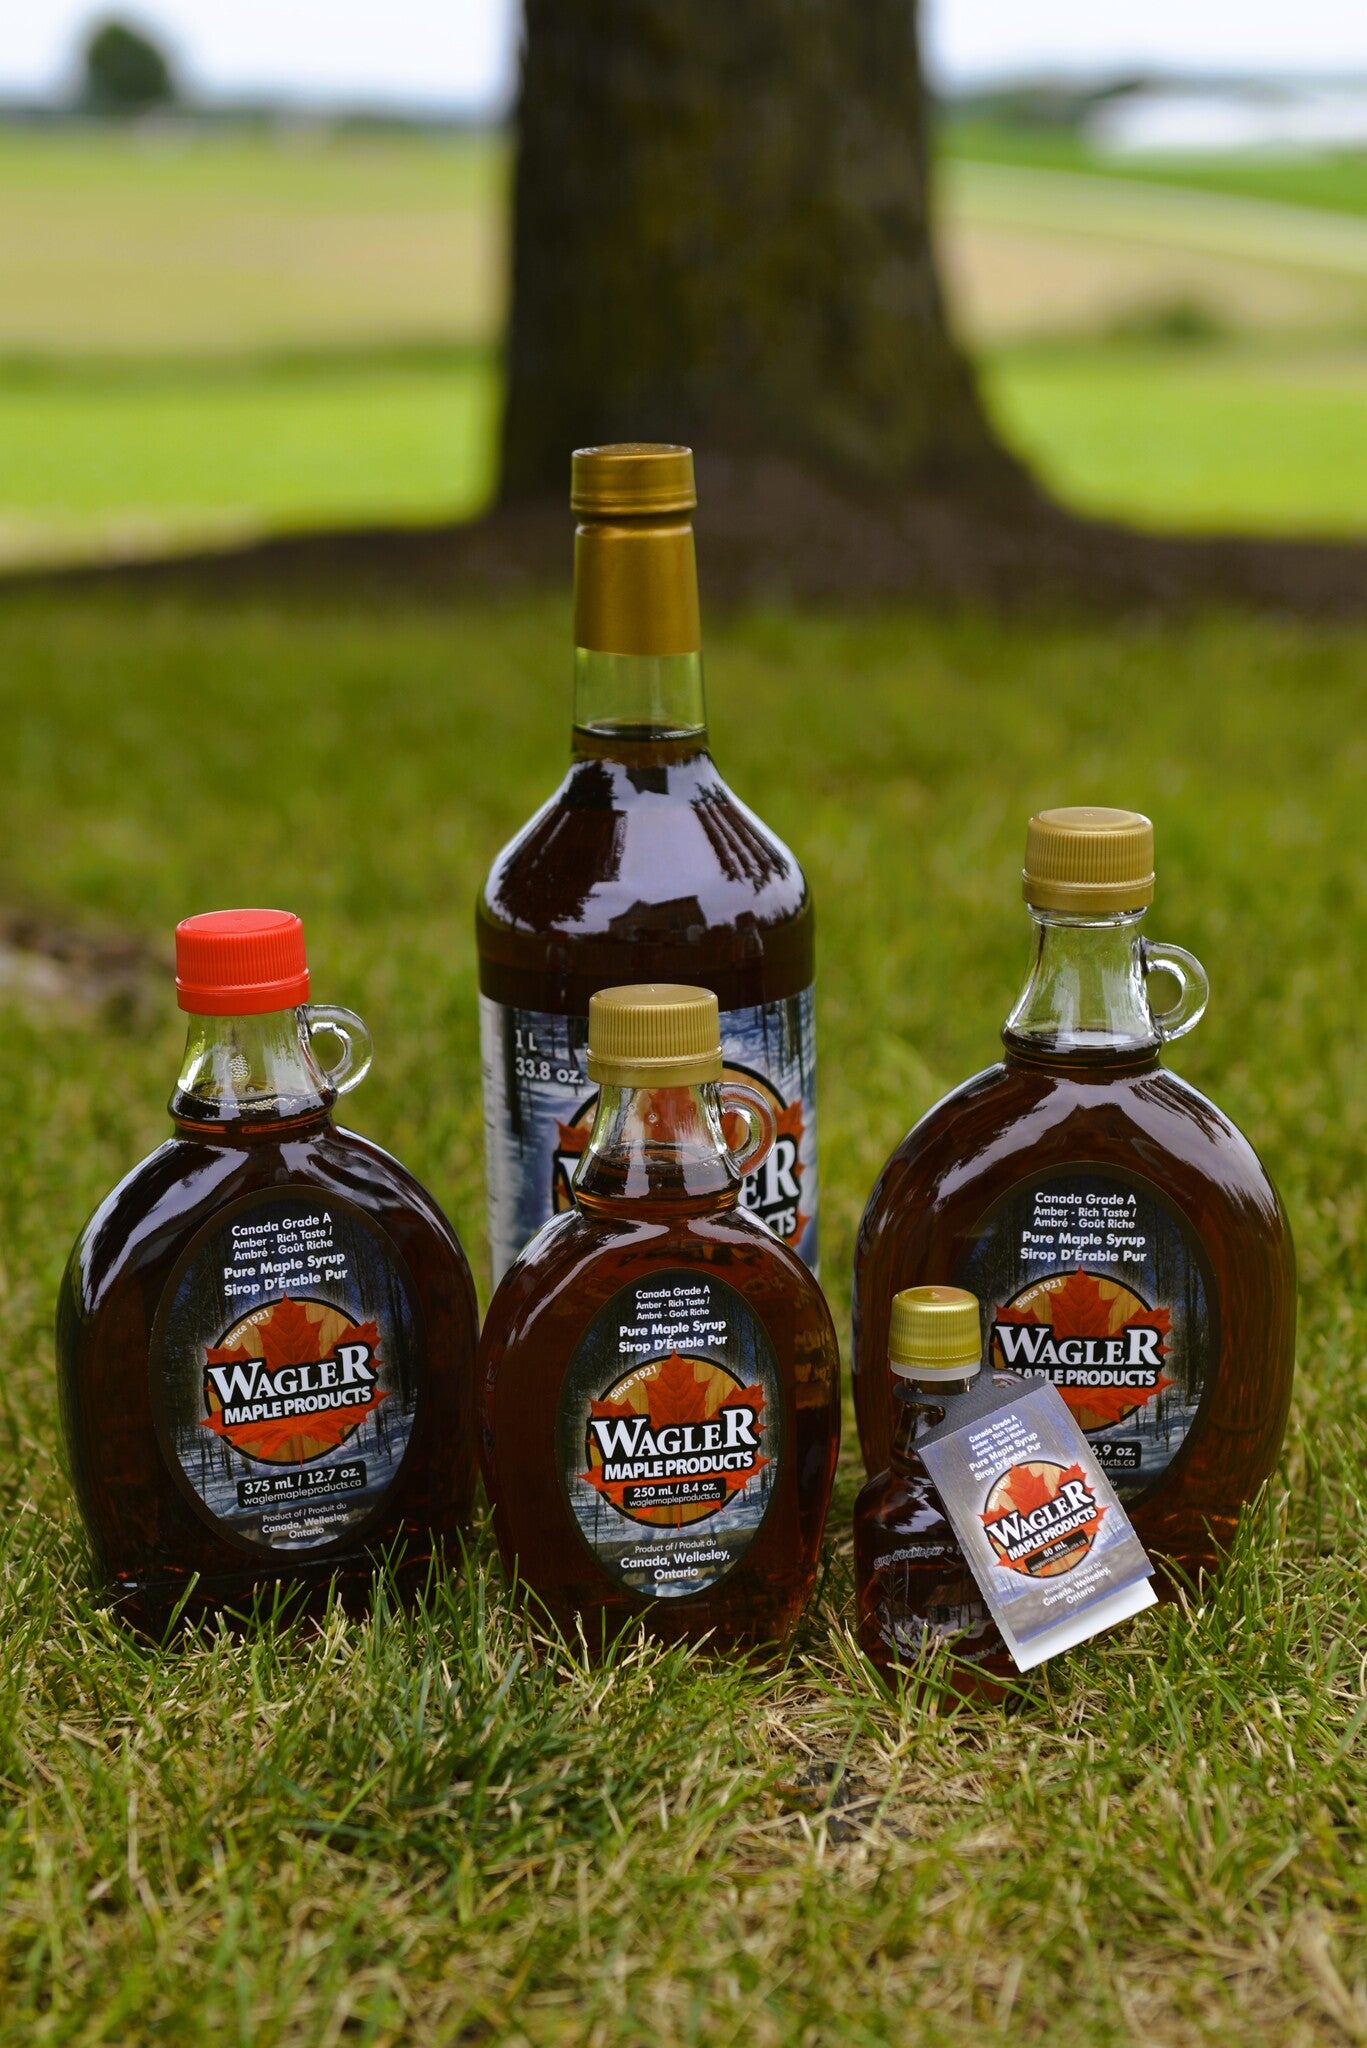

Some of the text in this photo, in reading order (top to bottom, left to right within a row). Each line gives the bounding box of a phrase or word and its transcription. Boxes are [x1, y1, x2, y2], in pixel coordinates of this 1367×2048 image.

[516, 1030, 537, 1050] 1 L
[515, 1056, 584, 1084] 33.8 oz.
[1035, 1192, 1136, 1205] Canada Grade A
[1034, 1206, 1068, 1216] Amber
[1078, 1207, 1099, 1217] Rich
[1102, 1208, 1129, 1217] Taste
[232, 1213, 332, 1236] Canada Grade A
[1034, 1217, 1068, 1227] Ambré
[1079, 1218, 1104, 1228] Goût
[1108, 1219, 1135, 1229] Riche
[232, 1238, 267, 1249] Amber
[277, 1233, 297, 1244] Rich
[300, 1229, 326, 1240] Taste
[1022, 1231, 1146, 1247] Pure Maple Syrup
[234, 1248, 268, 1261] Ambré
[278, 1243, 304, 1255] Goût
[307, 1239, 333, 1250] Riche
[1020, 1248, 1056, 1262] Sirop
[1124, 1250, 1147, 1262] Pur
[224, 1253, 345, 1279] Pure Maple Syrup
[224, 1282, 260, 1296] Sirop
[326, 1268, 348, 1281] Pur
[636, 1285, 710, 1299] Canada Grade A
[1015, 1279, 1062, 1308] Since 1921
[636, 1301, 662, 1309] Amber
[669, 1299, 684, 1308] Rich
[637, 1310, 662, 1320] Ambré
[669, 1308, 688, 1318] Goût
[690, 1308, 709, 1316] Riche
[225, 1310, 270, 1346] Since 1921
[620, 1320, 726, 1337] Pure Maple Syrup
[619, 1341, 650, 1353] Sirop
[708, 1335, 727, 1346] Pur
[995, 1326, 1161, 1365] WAGLER
[208, 1345, 375, 1403] WAGLER
[610, 1365, 657, 1400] Since 1921
[1066, 1369, 1156, 1386] PRODUCTS
[224, 1386, 372, 1424] MAPLE PRODUCTS
[591, 1408, 757, 1458] WAGLER
[969, 1428, 993, 1442] Canada
[992, 1419, 1011, 1431] Grade
[969, 1432, 1038, 1471] Pure Maple Syrup
[1092, 1444, 1136, 1456] 6.9 oz.
[605, 1451, 753, 1480] MAPLE PRODUCTS
[974, 1467, 995, 1481] Sirop
[1026, 1442, 1041, 1453] Pur
[244, 1480, 270, 1495] 375
[275, 1476, 294, 1490] mL
[308, 1469, 335, 1484] 12.7
[341, 1468, 360, 1478] oz.
[634, 1487, 655, 1498] 250
[658, 1485, 672, 1496] mL
[683, 1483, 698, 1494] 8.4
[702, 1484, 717, 1492] oz.
[243, 1479, 362, 1506] waglermapleproducts.ca
[630, 1492, 720, 1507] waglermapleproducts.ca
[263, 1511, 292, 1522] Product
[294, 1509, 302, 1517] of
[308, 1505, 334, 1515] Produit
[986, 1480, 1094, 1547] WAGLER
[262, 1521, 302, 1534] Canada,
[289, 1527, 325, 1539] Ontario
[1008, 1534, 1046, 1560] MAPLE
[1044, 1506, 1098, 1542] PRODUCTS
[635, 1544, 663, 1554] Product
[665, 1543, 674, 1551] of
[679, 1540, 704, 1549] Produit
[621, 1550, 730, 1568] Canada, Wellesley,
[654, 1566, 698, 1580] Ontario
[1066, 1585, 1096, 1604] Ontario
